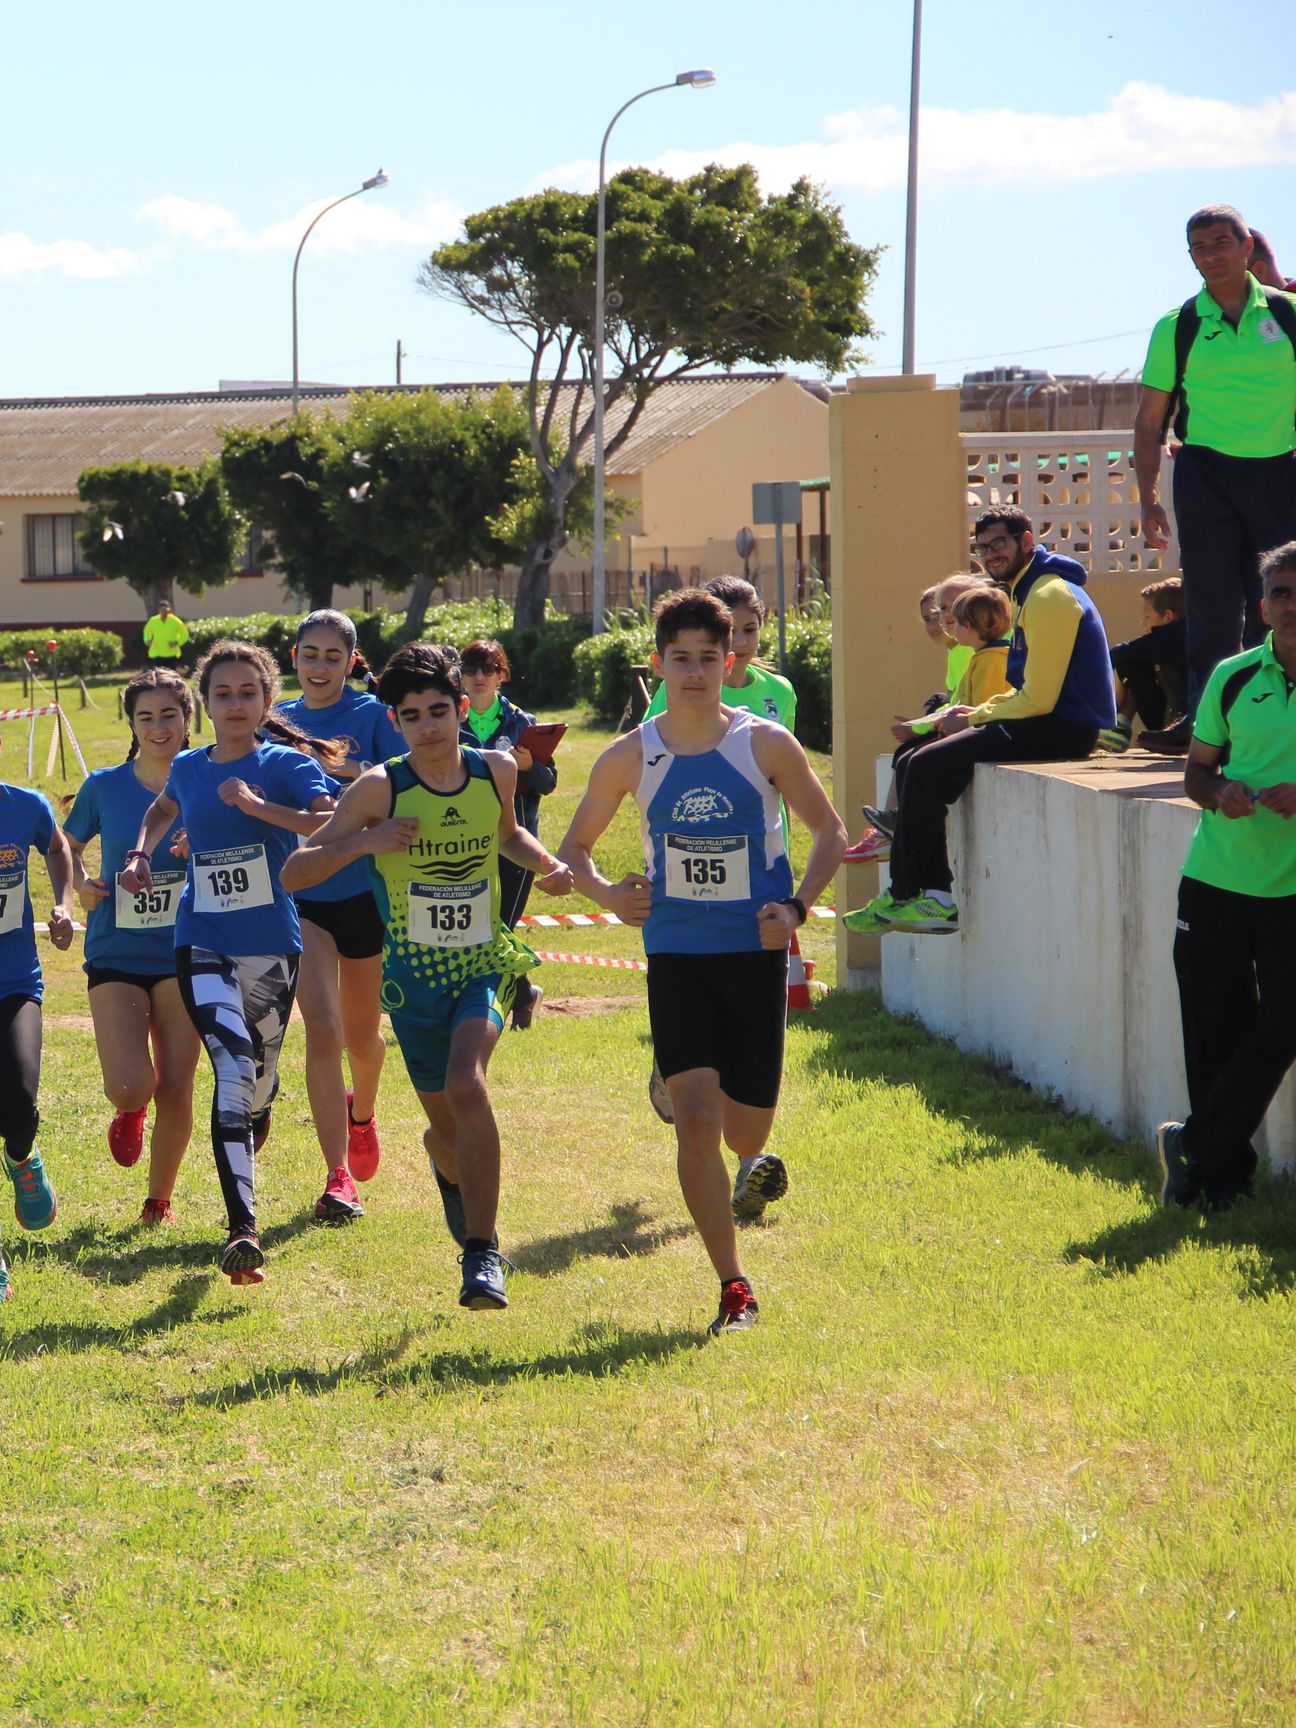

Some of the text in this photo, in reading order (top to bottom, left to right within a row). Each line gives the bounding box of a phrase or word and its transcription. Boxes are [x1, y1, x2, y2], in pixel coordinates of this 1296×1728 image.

[208, 867, 249, 896] 139
[681, 858, 726, 885] 135
[419, 882, 482, 892] FEDERACIÓN MELILLENSE
[134, 889, 171, 914] 357
[427, 904, 472, 931] 133
